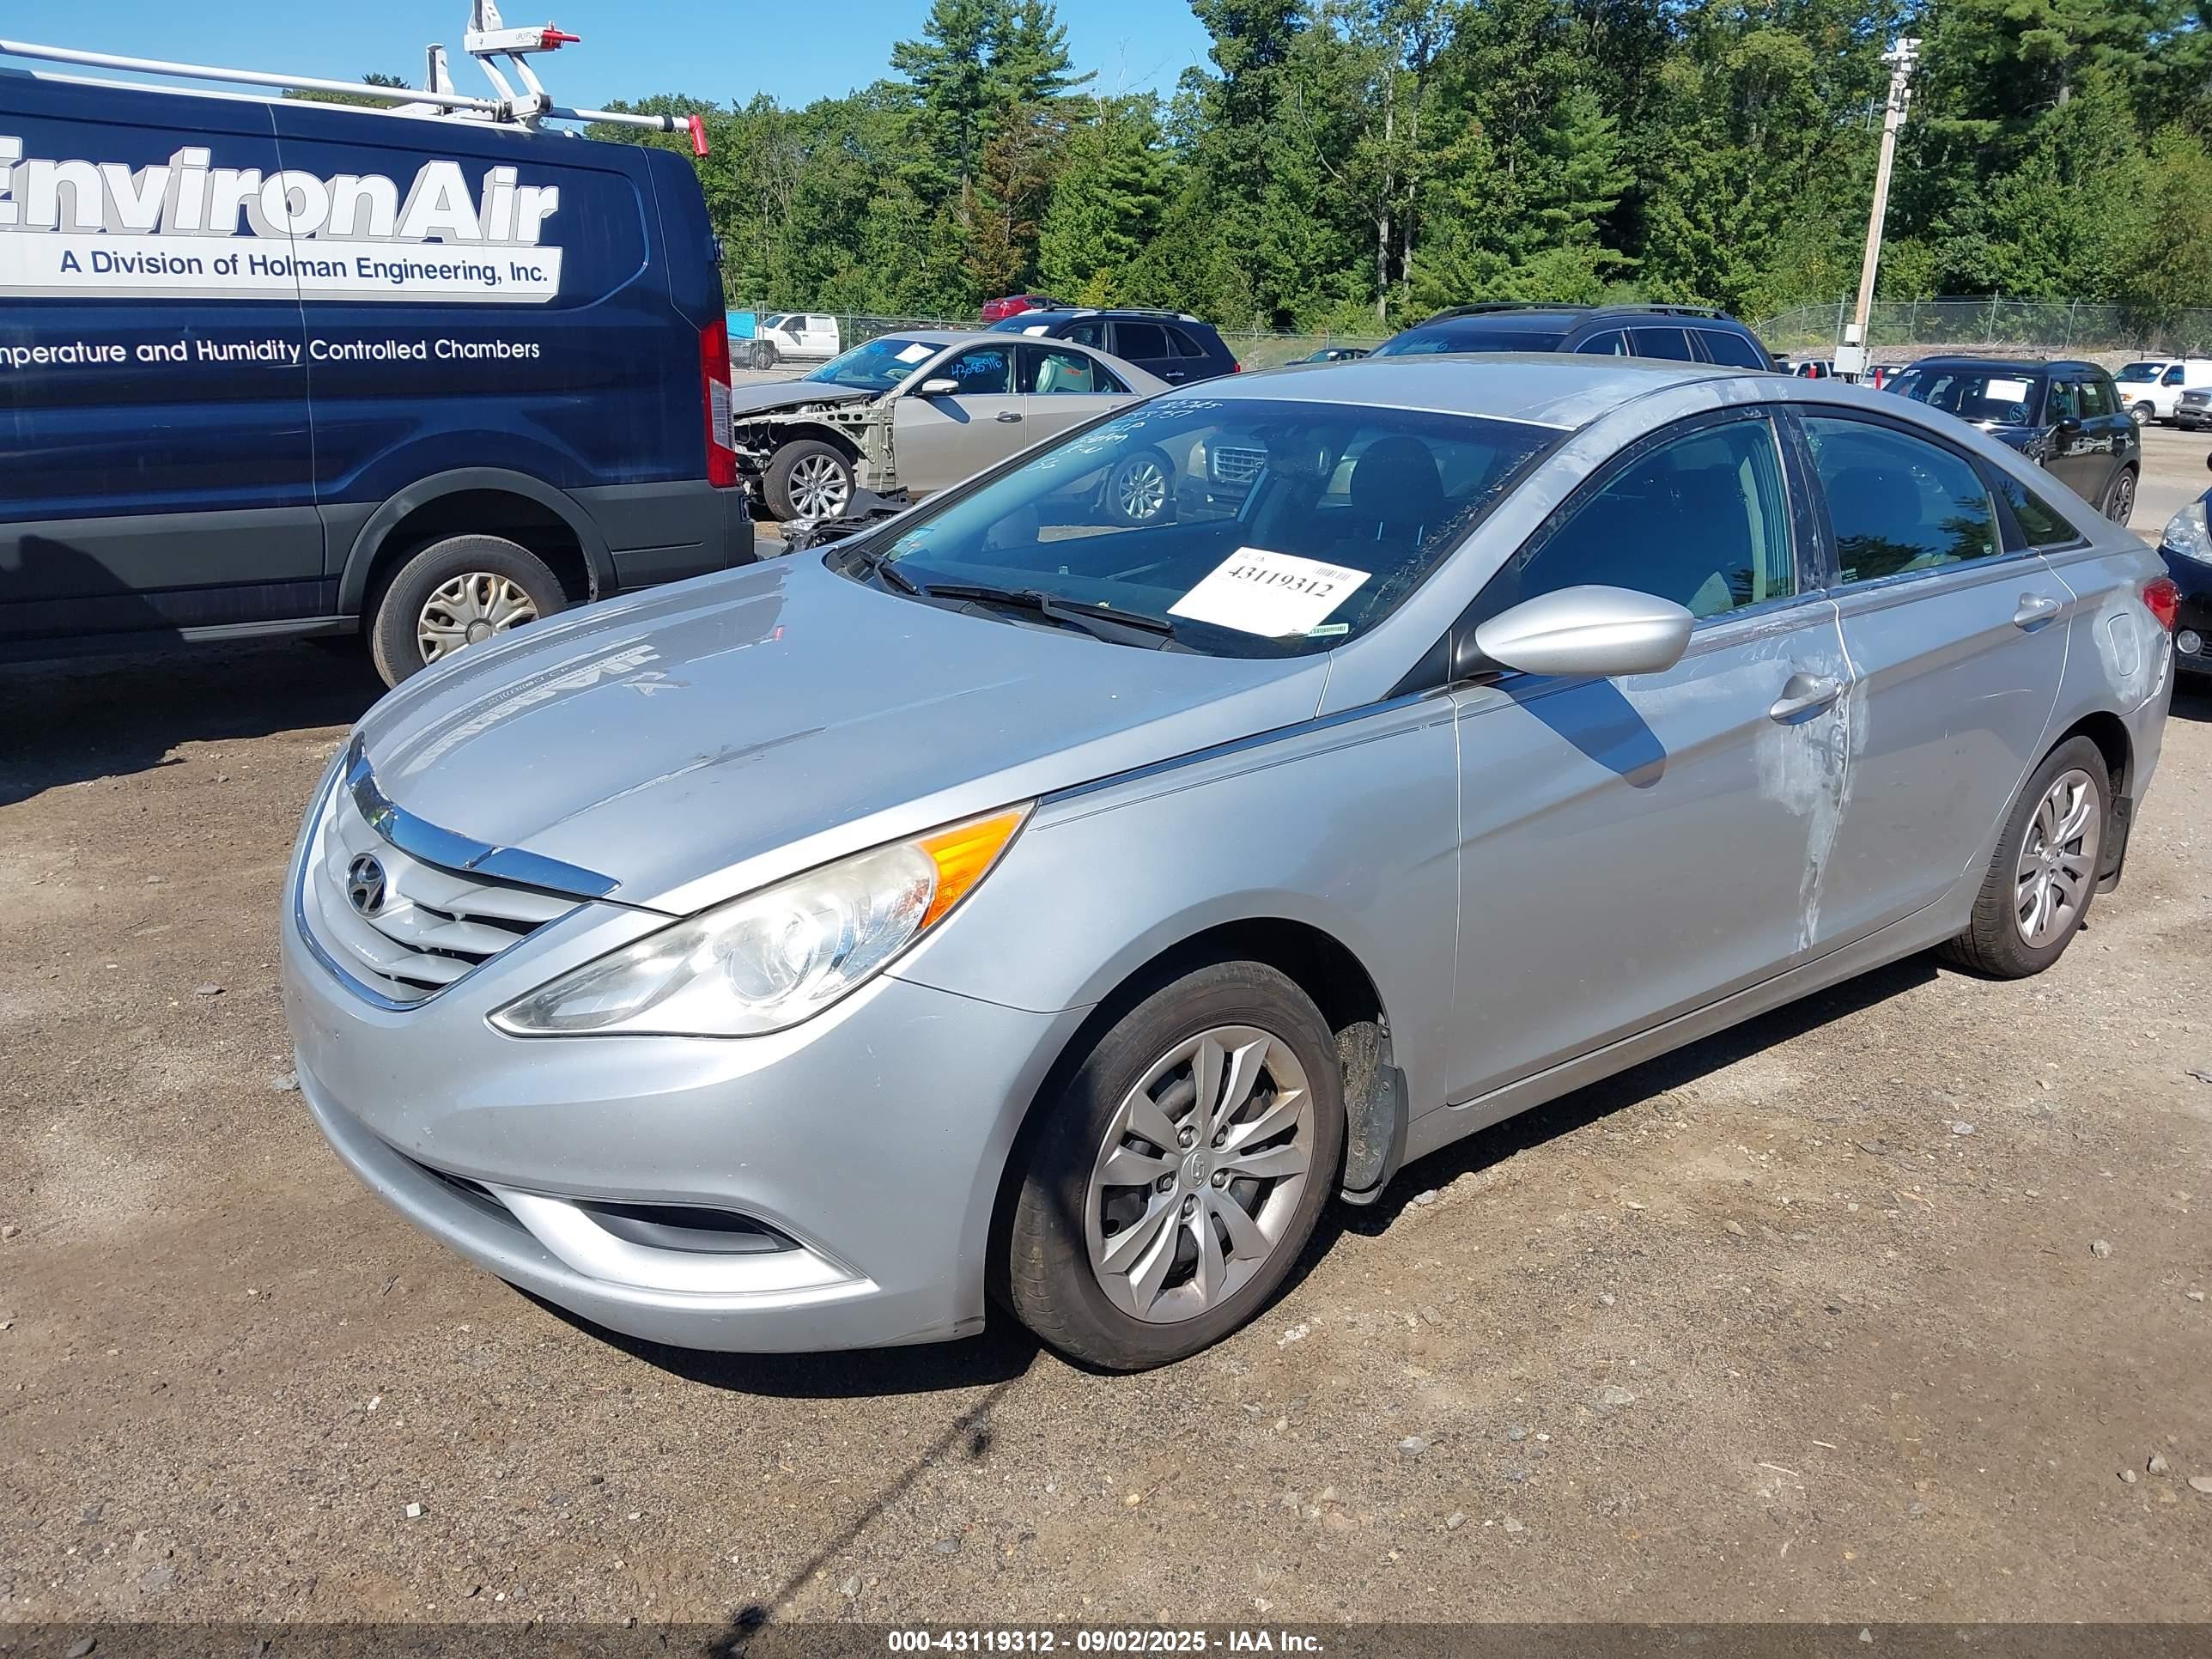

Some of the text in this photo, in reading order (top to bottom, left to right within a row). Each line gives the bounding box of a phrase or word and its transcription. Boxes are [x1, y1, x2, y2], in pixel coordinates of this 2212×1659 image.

[59, 250, 550, 286] A Division of Holman Engineering, Inc.
[136, 339, 189, 362] and
[195, 339, 301, 364] Humidity
[308, 338, 428, 361] Controlled
[434, 338, 541, 360] Chambers
[1228, 564, 1334, 598] 43119312
